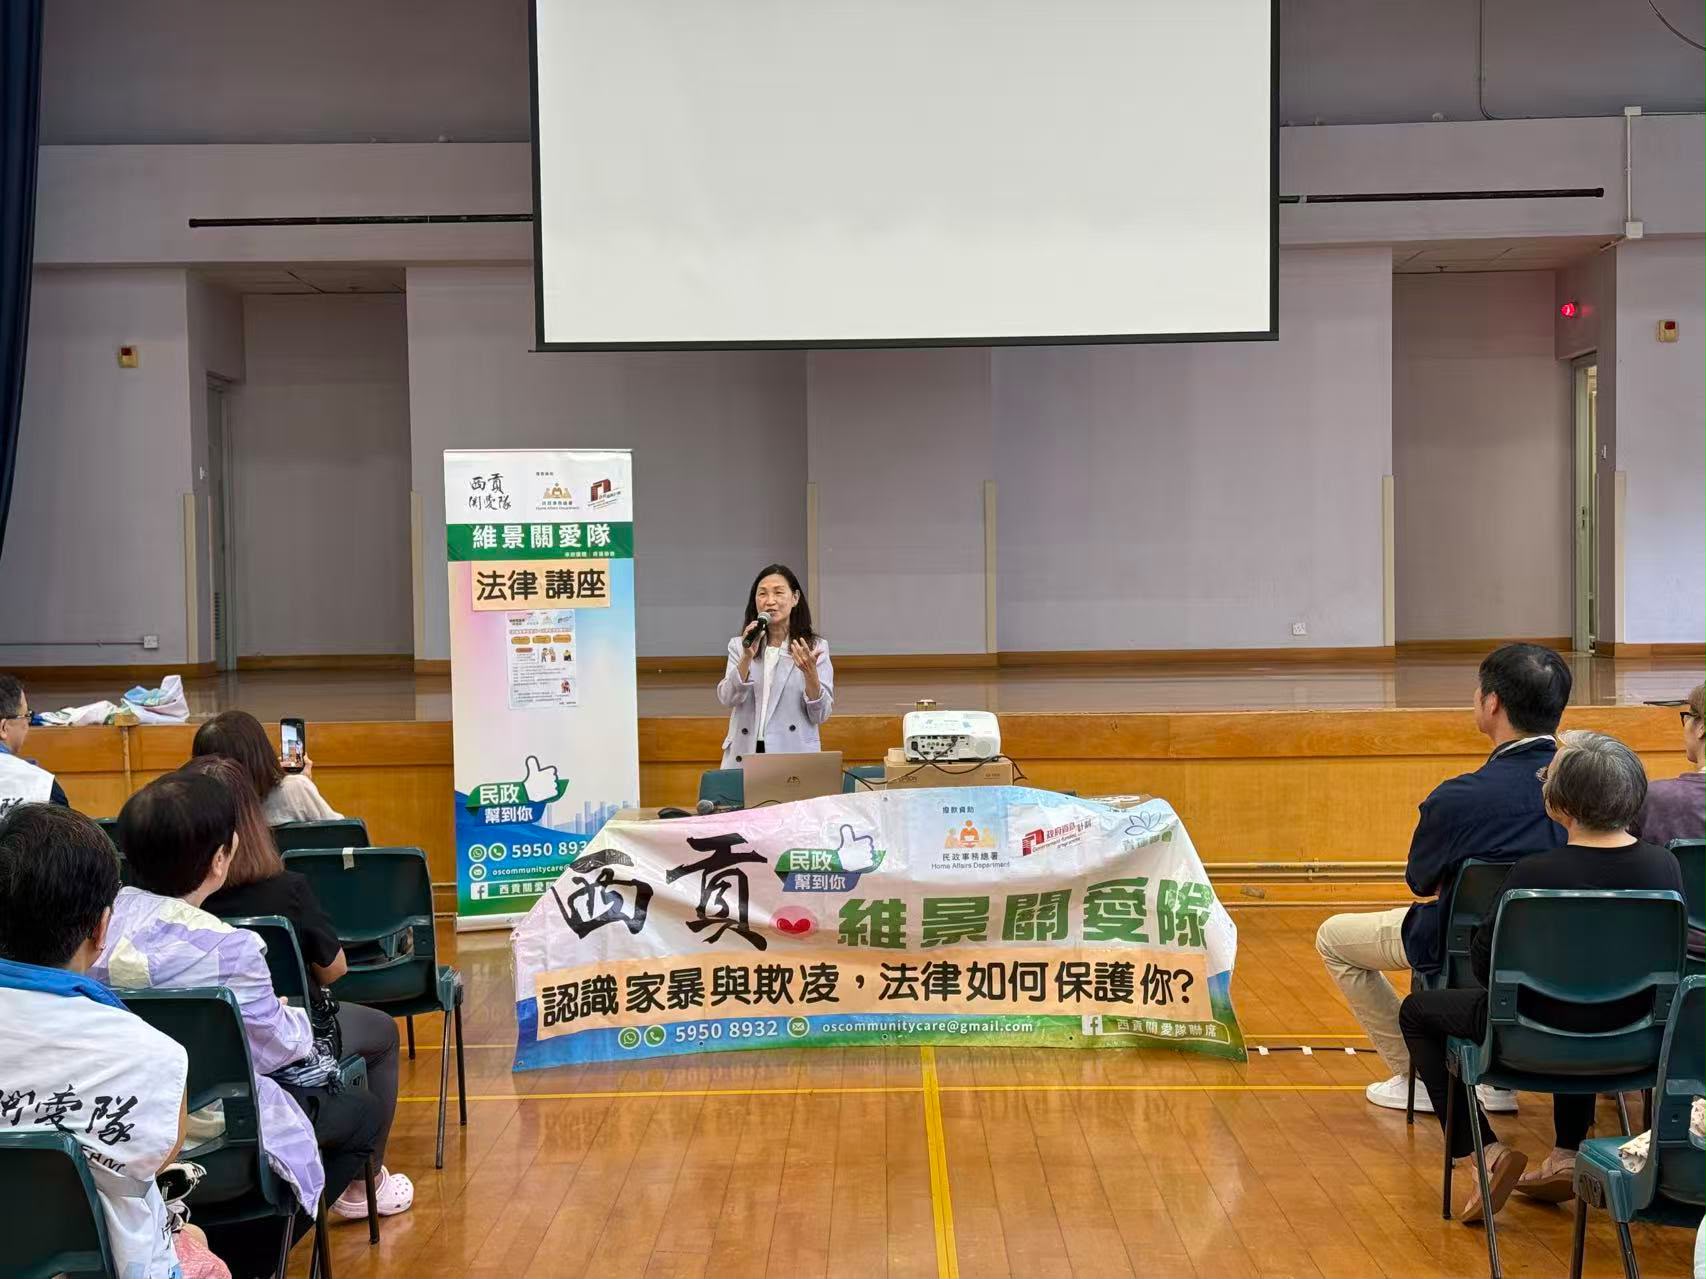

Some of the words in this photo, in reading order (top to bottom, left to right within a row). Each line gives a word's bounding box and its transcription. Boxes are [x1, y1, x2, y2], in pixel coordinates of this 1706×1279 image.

[470, 472, 506, 495] 西貢
[472, 523, 611, 550] 維景關愛隊
[476, 568, 606, 601] 法律講座
[480, 784, 520, 805] 民政
[485, 805, 533, 824] 幫到你
[511, 843, 553, 858] 5950
[789, 850, 833, 871] 民政
[942, 852, 998, 861] 民政事務總署
[973, 862, 1010, 870] Department
[550, 832, 768, 952] 西貢
[794, 874, 846, 890] 幫到你
[838, 876, 1215, 950] 維景關愛隊
[675, 1023, 722, 1042] 5950
[729, 1020, 778, 1038] 8932
[822, 1020, 1034, 1034] oscommunitycare@gmail.com
[1117, 1018, 1217, 1038] 西貢關愛隊聯席
